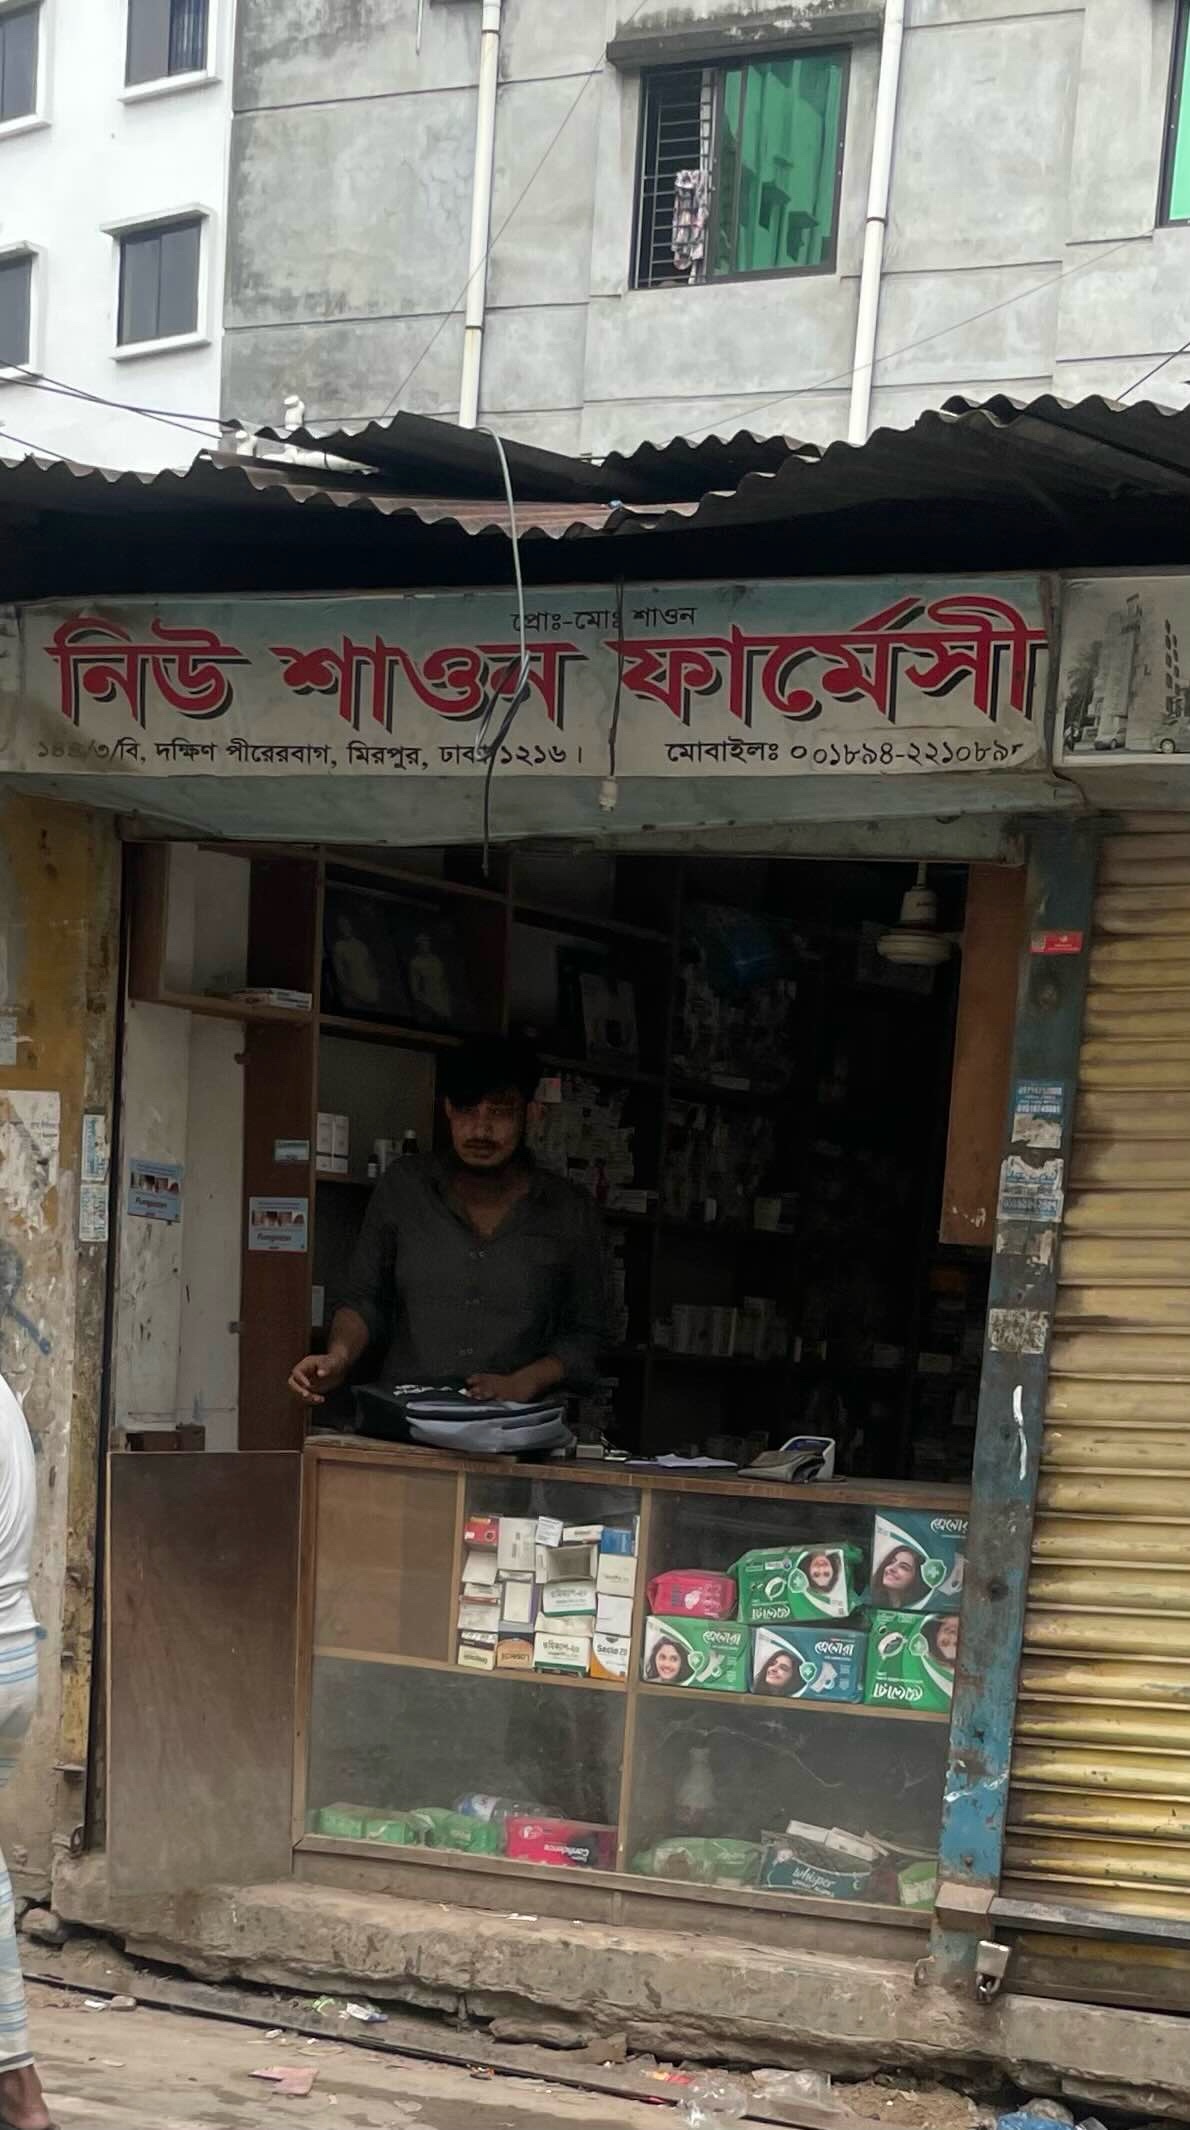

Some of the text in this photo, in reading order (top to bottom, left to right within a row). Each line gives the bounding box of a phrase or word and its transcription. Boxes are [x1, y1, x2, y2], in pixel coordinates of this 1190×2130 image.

[632, 607, 698, 628] শাওন
[43, 595, 1048, 733] নিউ শাওন ফার্মেসী
[154, 737, 218, 763] দক্ষিণ
[226, 738, 337, 768] পীরেরবাগ,
[347, 740, 428, 770] মিরপুর,
[665, 736, 779, 764] মোবাইলঃ
